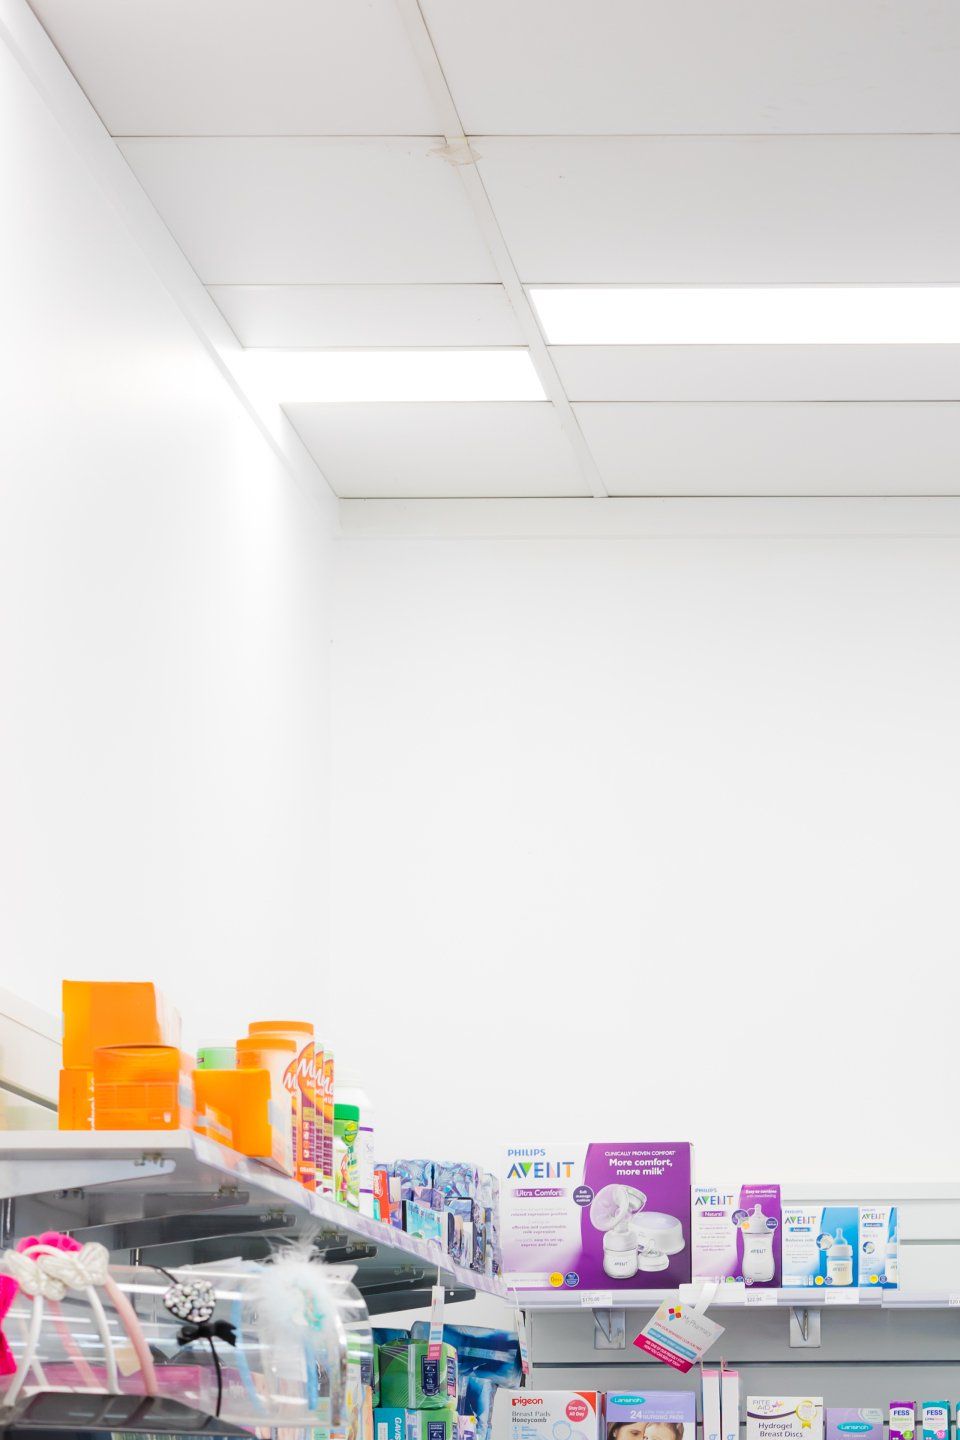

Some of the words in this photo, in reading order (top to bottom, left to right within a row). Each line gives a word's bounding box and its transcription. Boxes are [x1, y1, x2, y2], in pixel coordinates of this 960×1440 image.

[507, 1148, 546, 1156] PHILIPS
[609, 1158, 632, 1166] More
[634, 1157, 672, 1167] comfort,
[506, 1161, 575, 1179] AVENT
[534, 1189, 563, 1197] Comfort
[694, 1195, 734, 1205] AVENT
[784, 1215, 816, 1224] AVENT
[512, 1397, 543, 1406] pigeon
[630, 1410, 642, 1419] 24
[758, 1422, 793, 1430] Hydrogel
